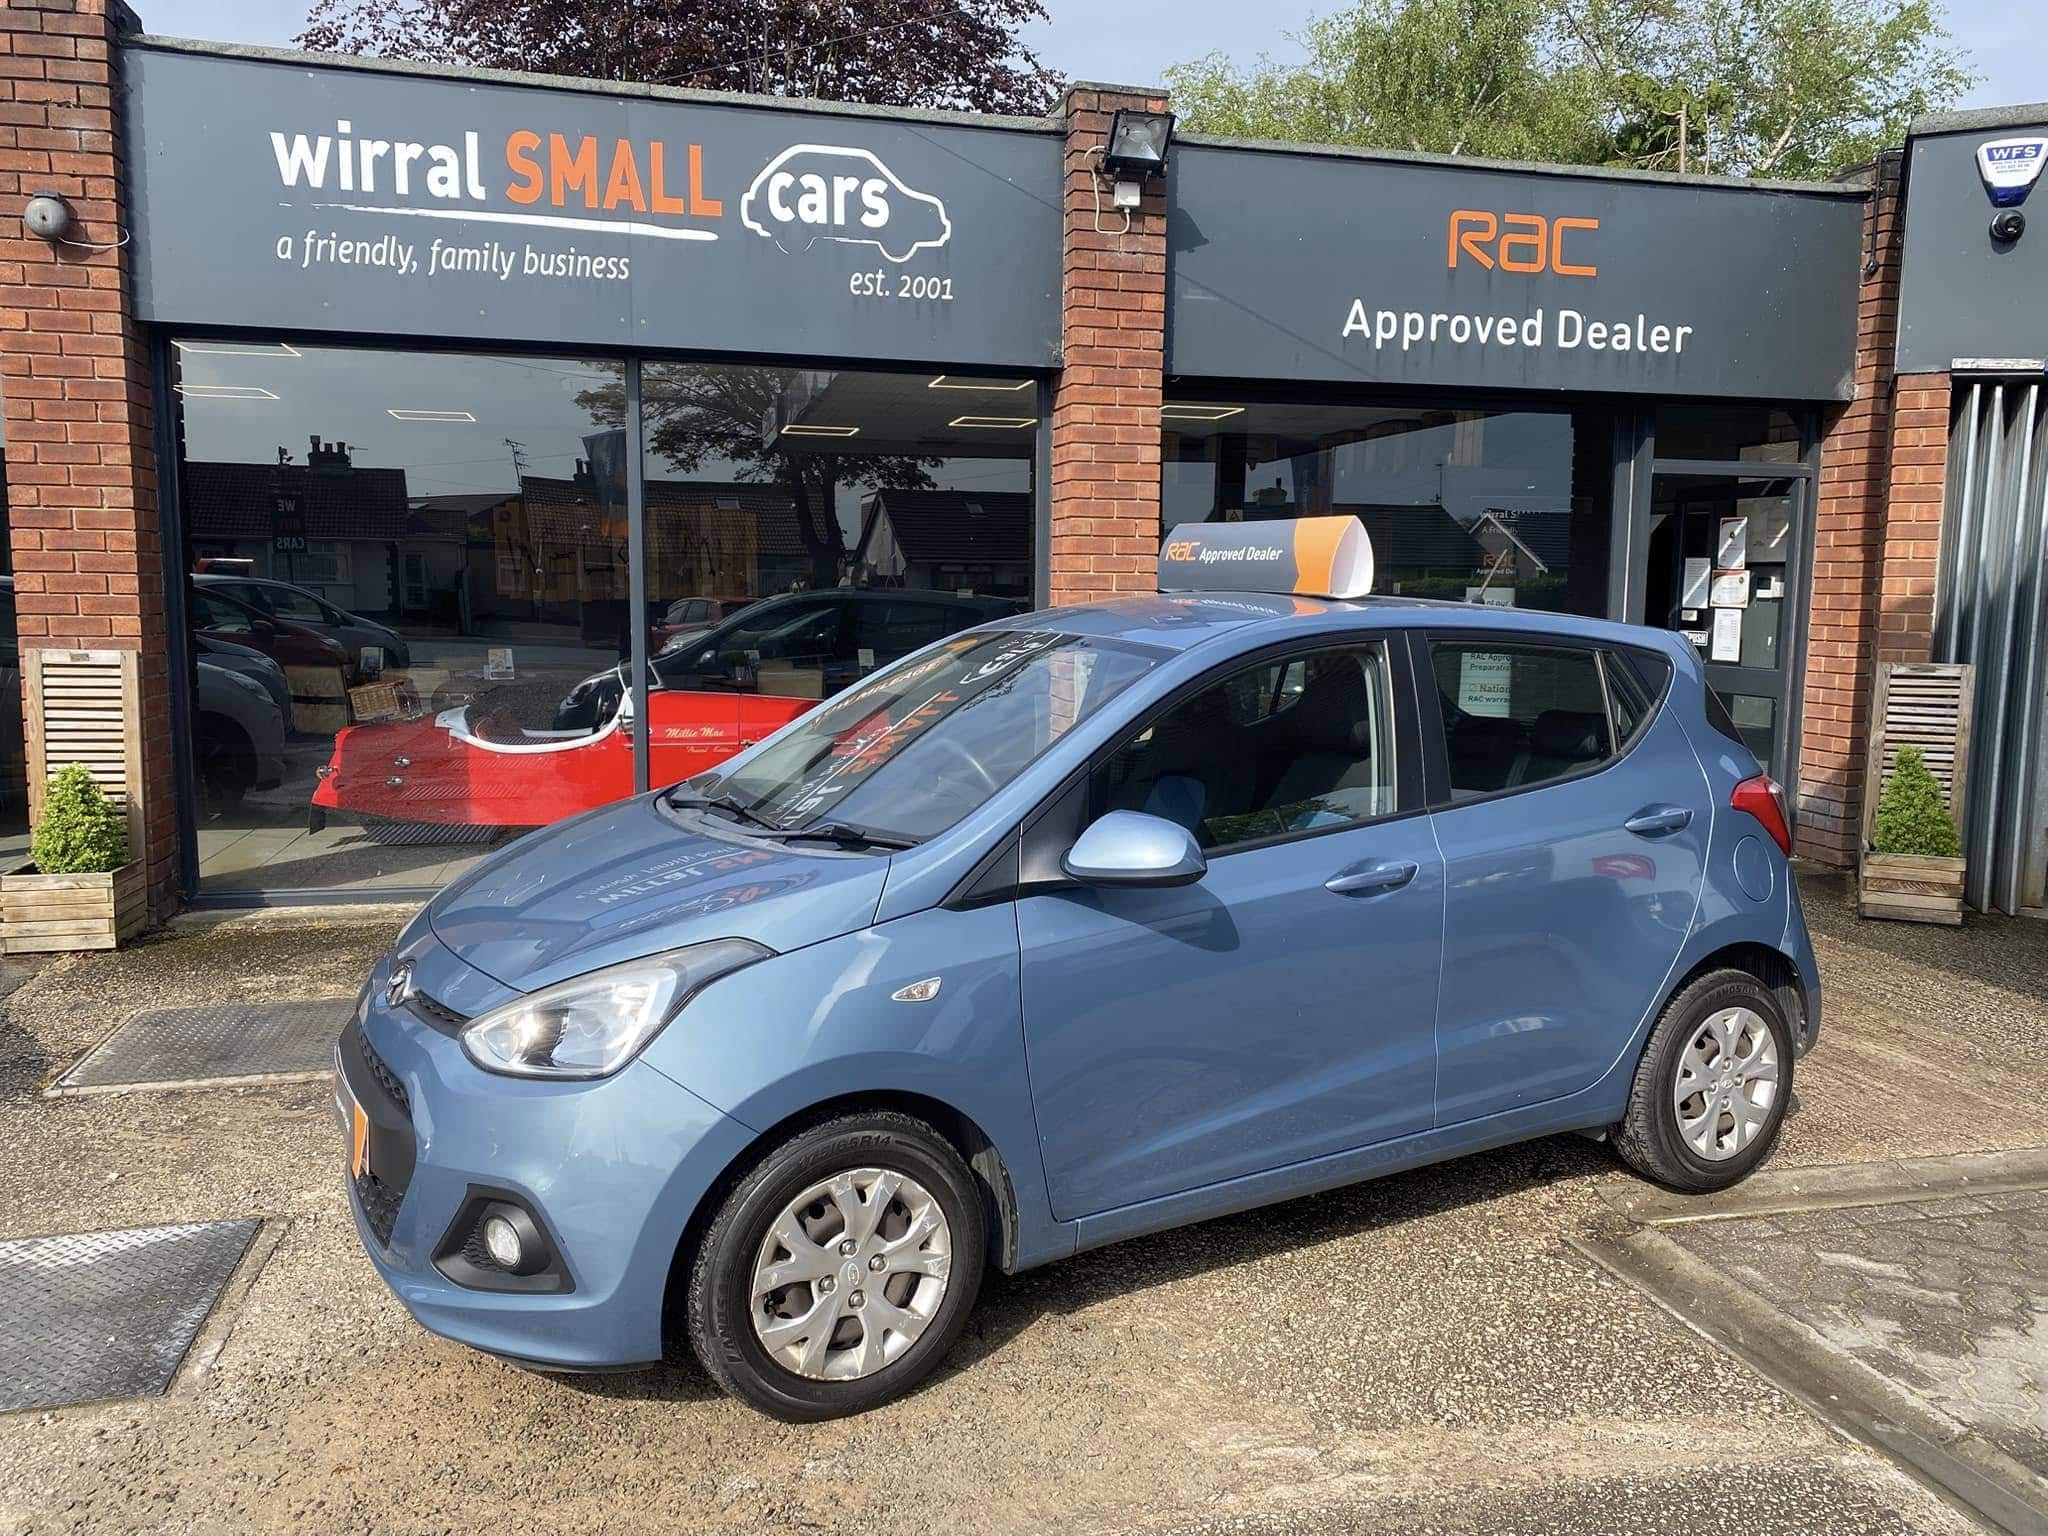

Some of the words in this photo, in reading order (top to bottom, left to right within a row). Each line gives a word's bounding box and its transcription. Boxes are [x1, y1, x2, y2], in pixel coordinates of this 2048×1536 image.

[268, 119, 487, 202] wirral
[505, 130, 723, 218] SMALL
[767, 171, 891, 229] cars
[1992, 146, 2036, 160] WFS
[276, 236, 293, 260] a
[301, 229, 418, 275] friendly,
[427, 241, 516, 281] family
[522, 243, 630, 281] business
[1448, 211, 1597, 277] RAC
[849, 268, 890, 297] est.
[897, 273, 954, 300] 2001
[1342, 298, 1543, 352] Approved
[1557, 308, 1693, 354] Dealer
[1165, 541, 1200, 562] RAC
[1199, 546, 1245, 565] Approved
[1245, 545, 1283, 561] Dealer
[665, 727, 698, 738] Millie
